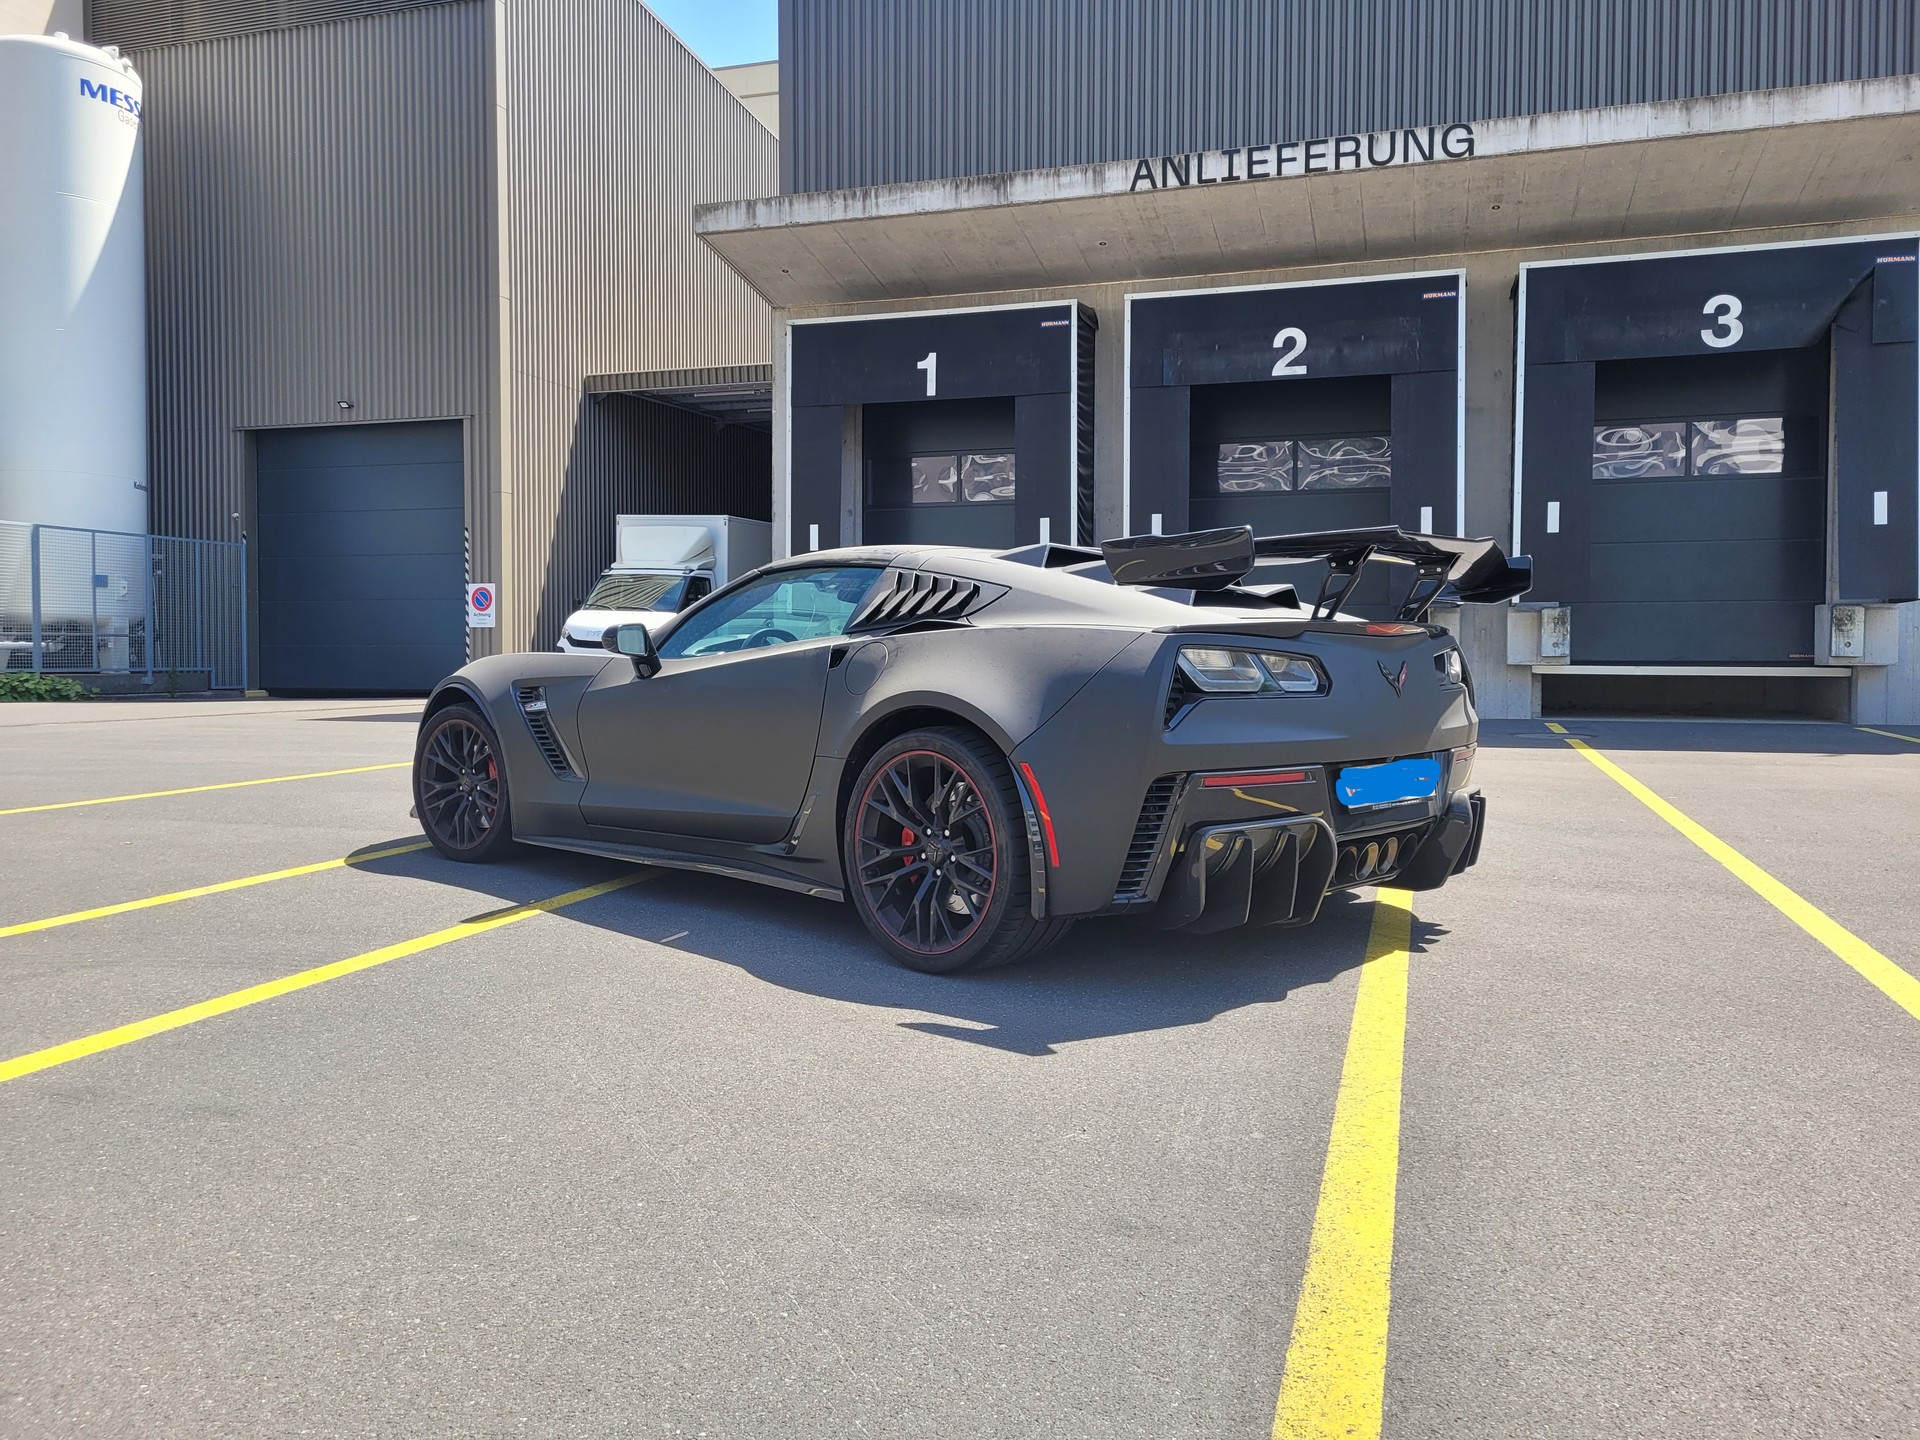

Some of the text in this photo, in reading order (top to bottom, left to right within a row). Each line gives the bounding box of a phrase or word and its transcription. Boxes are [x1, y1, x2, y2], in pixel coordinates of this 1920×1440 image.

[79, 77, 143, 122] MESS
[1130, 123, 1475, 192] ANLIEFERUNG
[1700, 294, 1743, 347] 3
[916, 352, 937, 396] 1
[1271, 327, 1308, 377] 2
